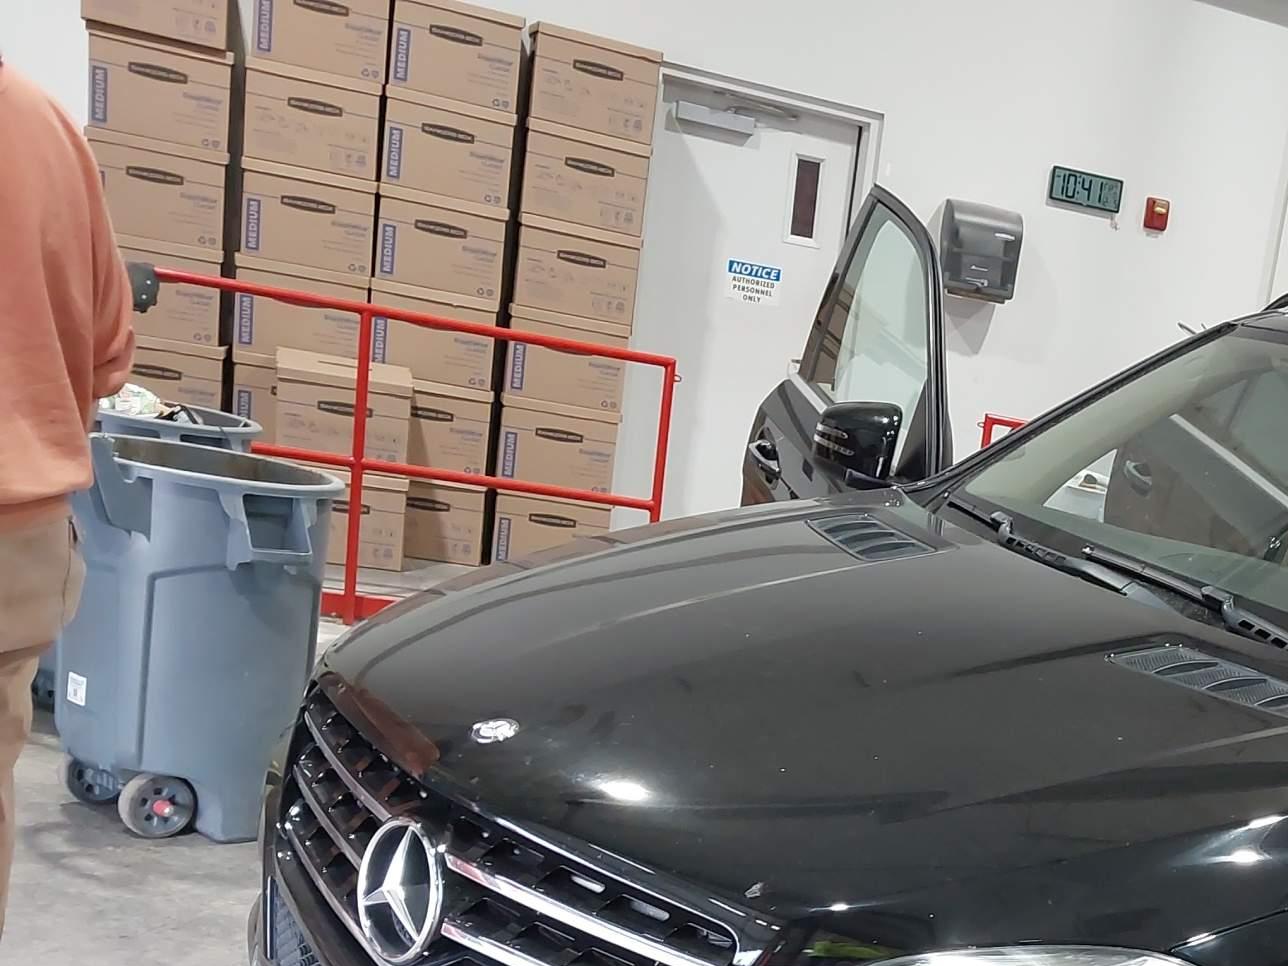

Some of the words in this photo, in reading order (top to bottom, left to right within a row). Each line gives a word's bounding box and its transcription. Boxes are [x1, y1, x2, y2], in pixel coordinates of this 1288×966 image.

[259, 0, 271, 50] MEDIUM
[396, 31, 409, 79] MEDIUM
[94, 68, 105, 120] MEDIUM
[389, 129, 401, 177] MEDIUM
[1061, 172, 1104, 204] 10:41
[247, 201, 259, 249] MEDIUM
[383, 226, 395, 273] MEDIUM
[731, 262, 779, 280] NOTICE
[732, 275, 775, 289] AUTHORIZED
[732, 284, 772, 297] PERSONNEL
[742, 294, 761, 303] ONLY
[241, 296, 252, 343] MEDIUM
[513, 344, 524, 388] MEDIUM
[504, 433, 516, 477] MEDIUM
